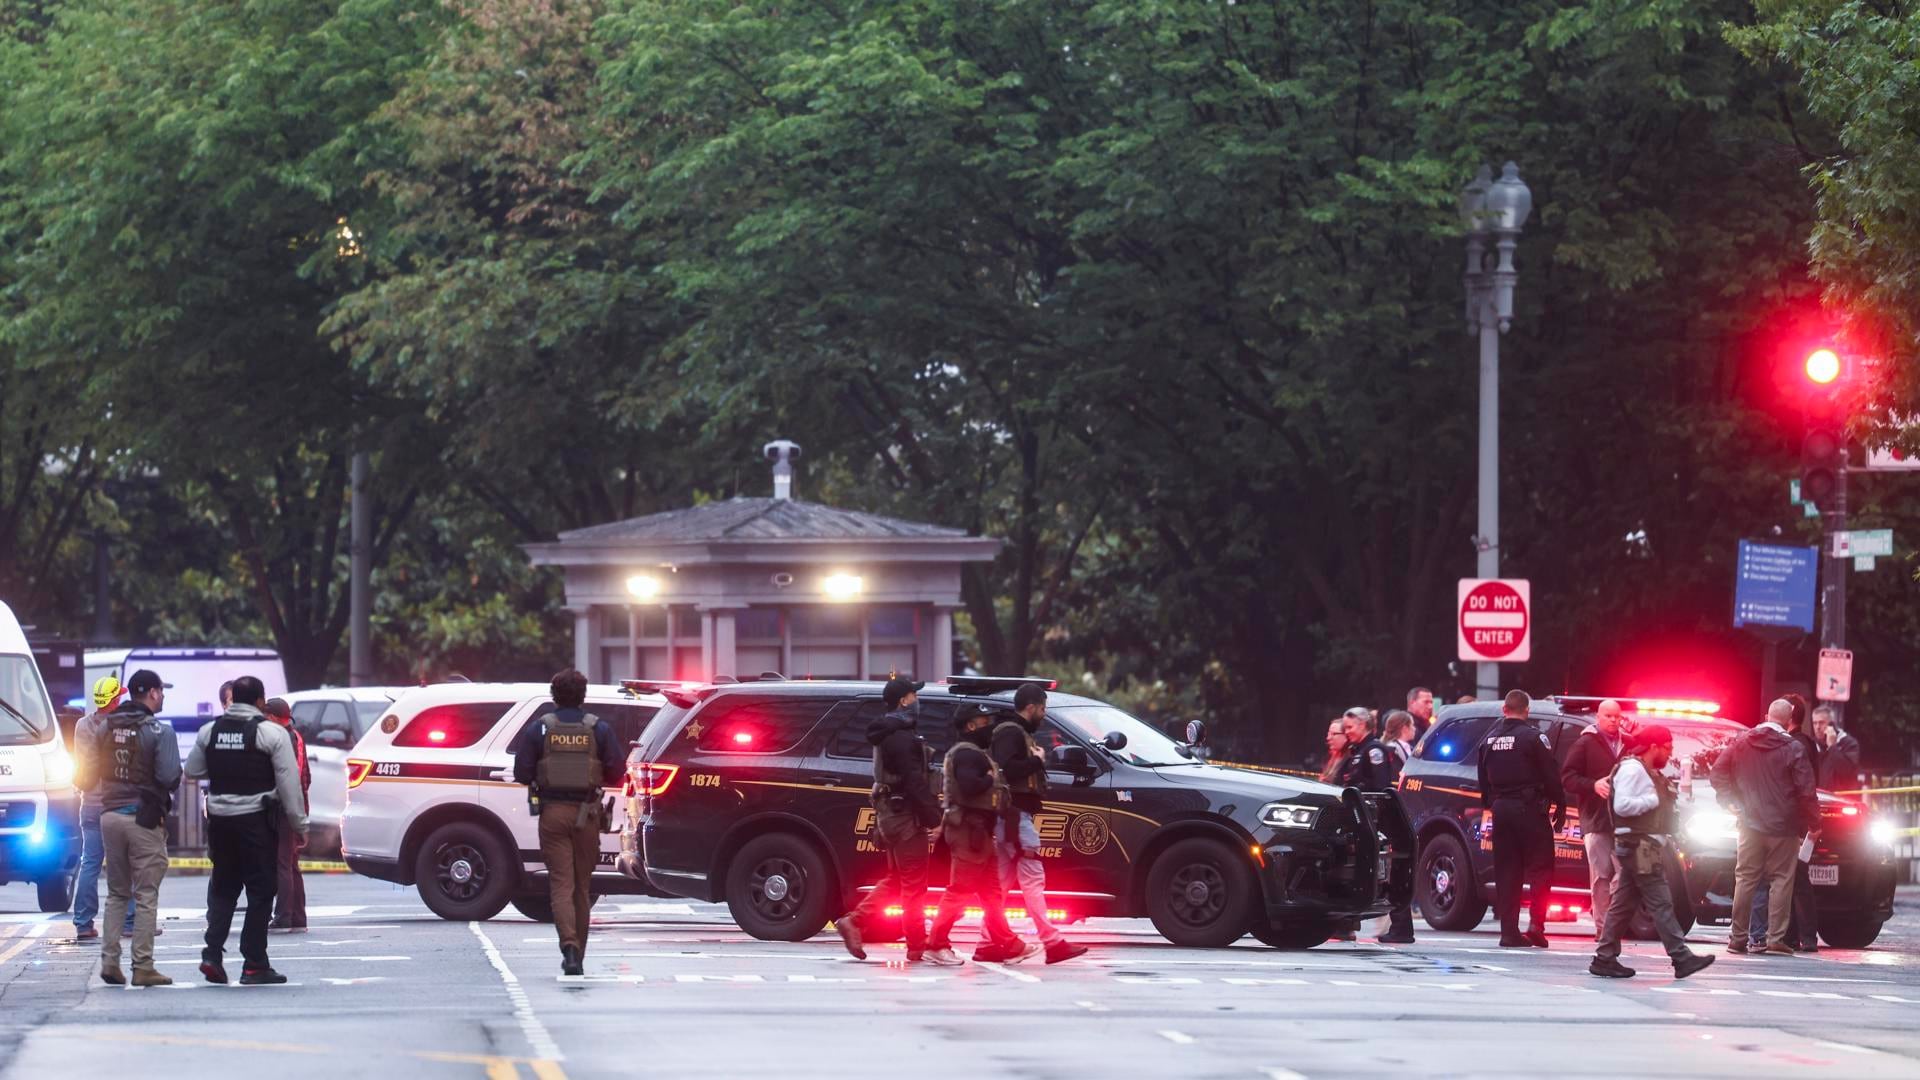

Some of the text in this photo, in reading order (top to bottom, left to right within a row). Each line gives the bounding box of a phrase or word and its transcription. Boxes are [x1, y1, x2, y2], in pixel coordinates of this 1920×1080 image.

[1469, 595, 1518, 609] DO NOT
[1474, 630, 1514, 644] ENTER
[217, 732, 244, 743] POLICE
[551, 734, 589, 745] POLICE
[1491, 743, 1513, 751] OLICE
[376, 763, 400, 776] 4413
[689, 774, 720, 787] 1874
[1555, 847, 1583, 859] SERVICE
